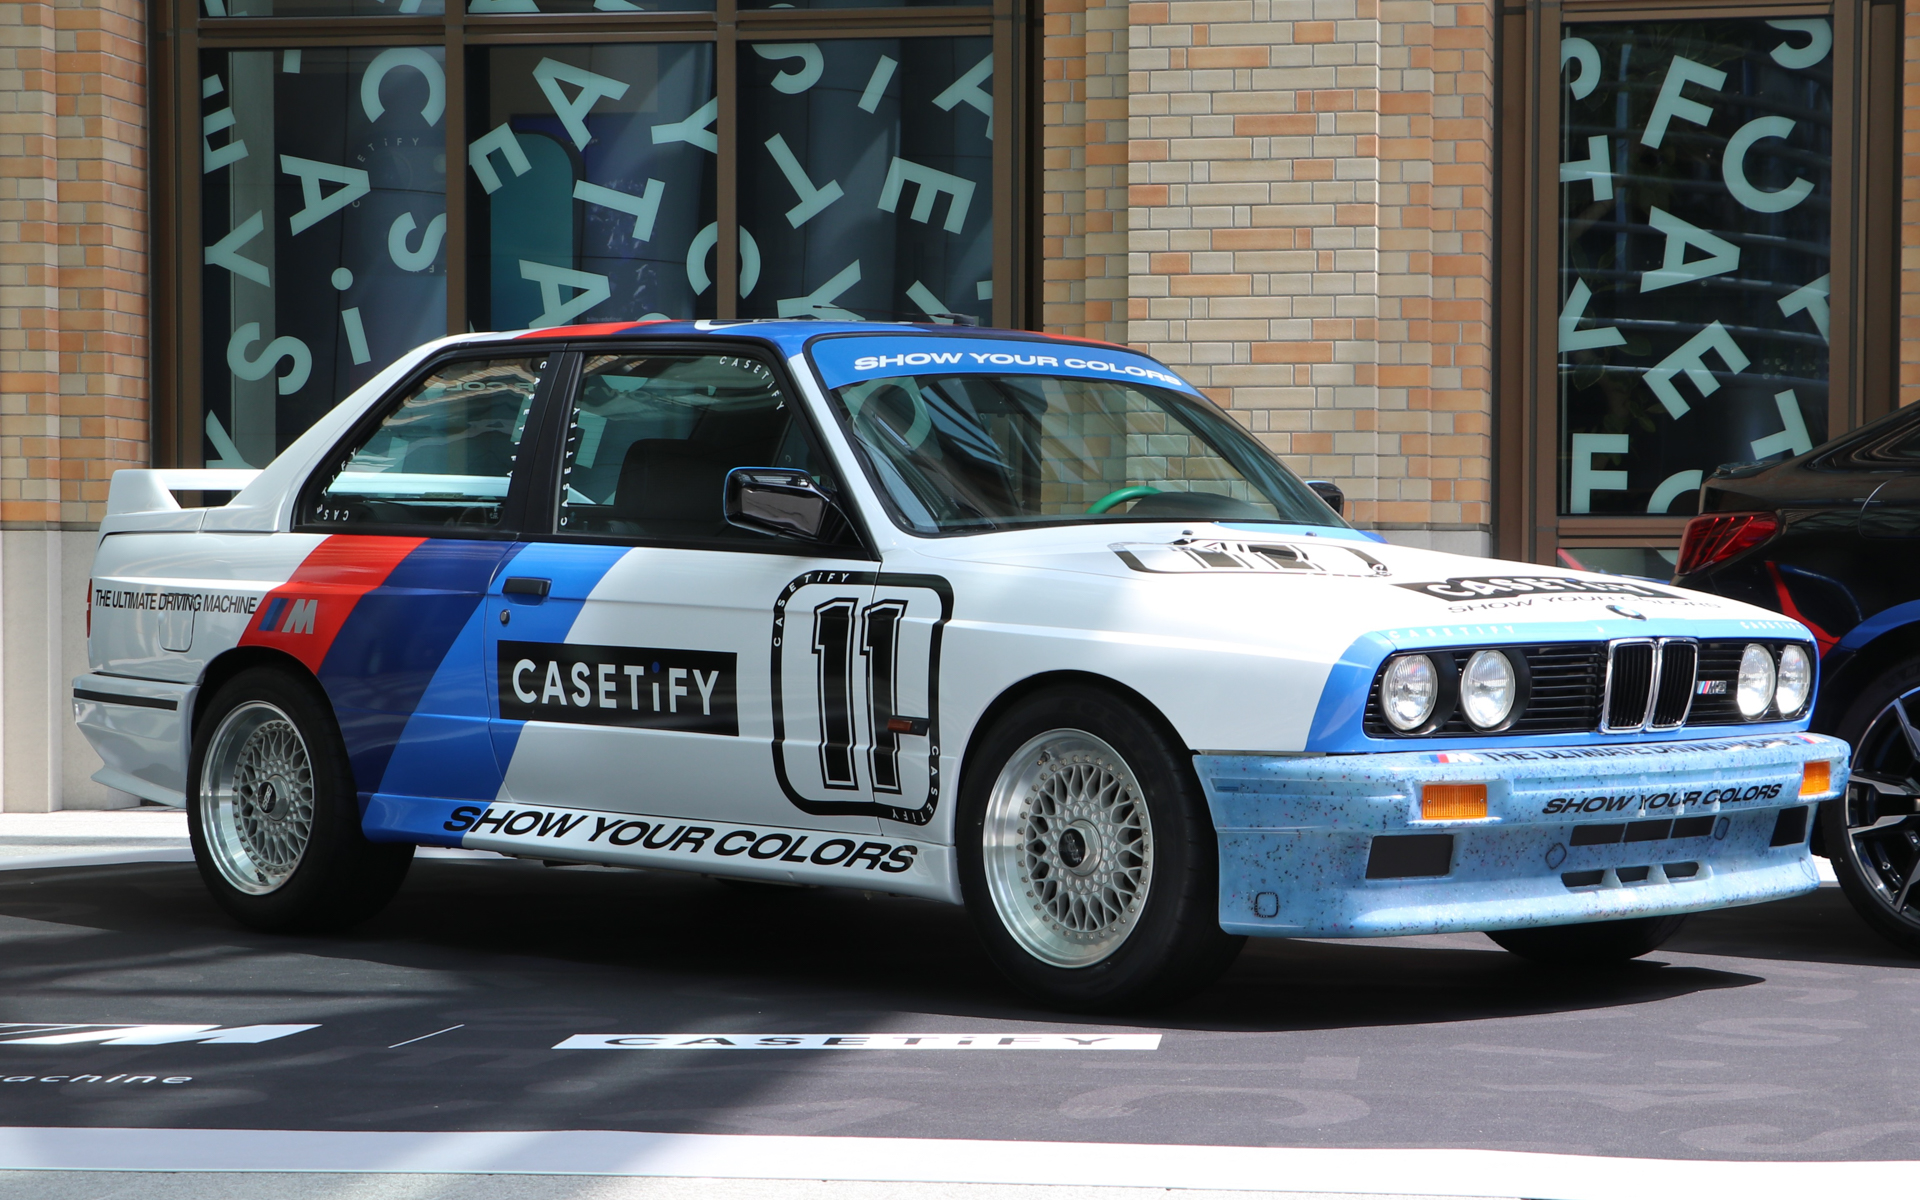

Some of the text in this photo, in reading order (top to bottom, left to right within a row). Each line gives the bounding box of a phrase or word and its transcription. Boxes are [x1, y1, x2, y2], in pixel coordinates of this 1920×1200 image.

[532, 56, 631, 153] A
[1640, 54, 1728, 150] F
[279, 154, 371, 237] A
[764, 132, 845, 229] T
[877, 156, 977, 235] E
[1722, 115, 1815, 213] C
[572, 177, 666, 242] T
[1640, 205, 1741, 293] A
[226, 321, 313, 395] S
[854, 352, 1183, 387] SHOW YOUR COLORS
[1642, 319, 1751, 421] E
[95, 589, 257, 615] THE ULTIMATE DRIVING MACHINE
[281, 598, 318, 635] M
[1448, 598, 1533, 613] SHOW
[512, 658, 720, 716] CASETiFY
[811, 597, 909, 796] 11
[1541, 783, 1783, 815] SHOW YOUR COLORS
[443, 807, 918, 874] SHOW YOUR COLORS
[604, 1036, 1113, 1047] CASETiFY
